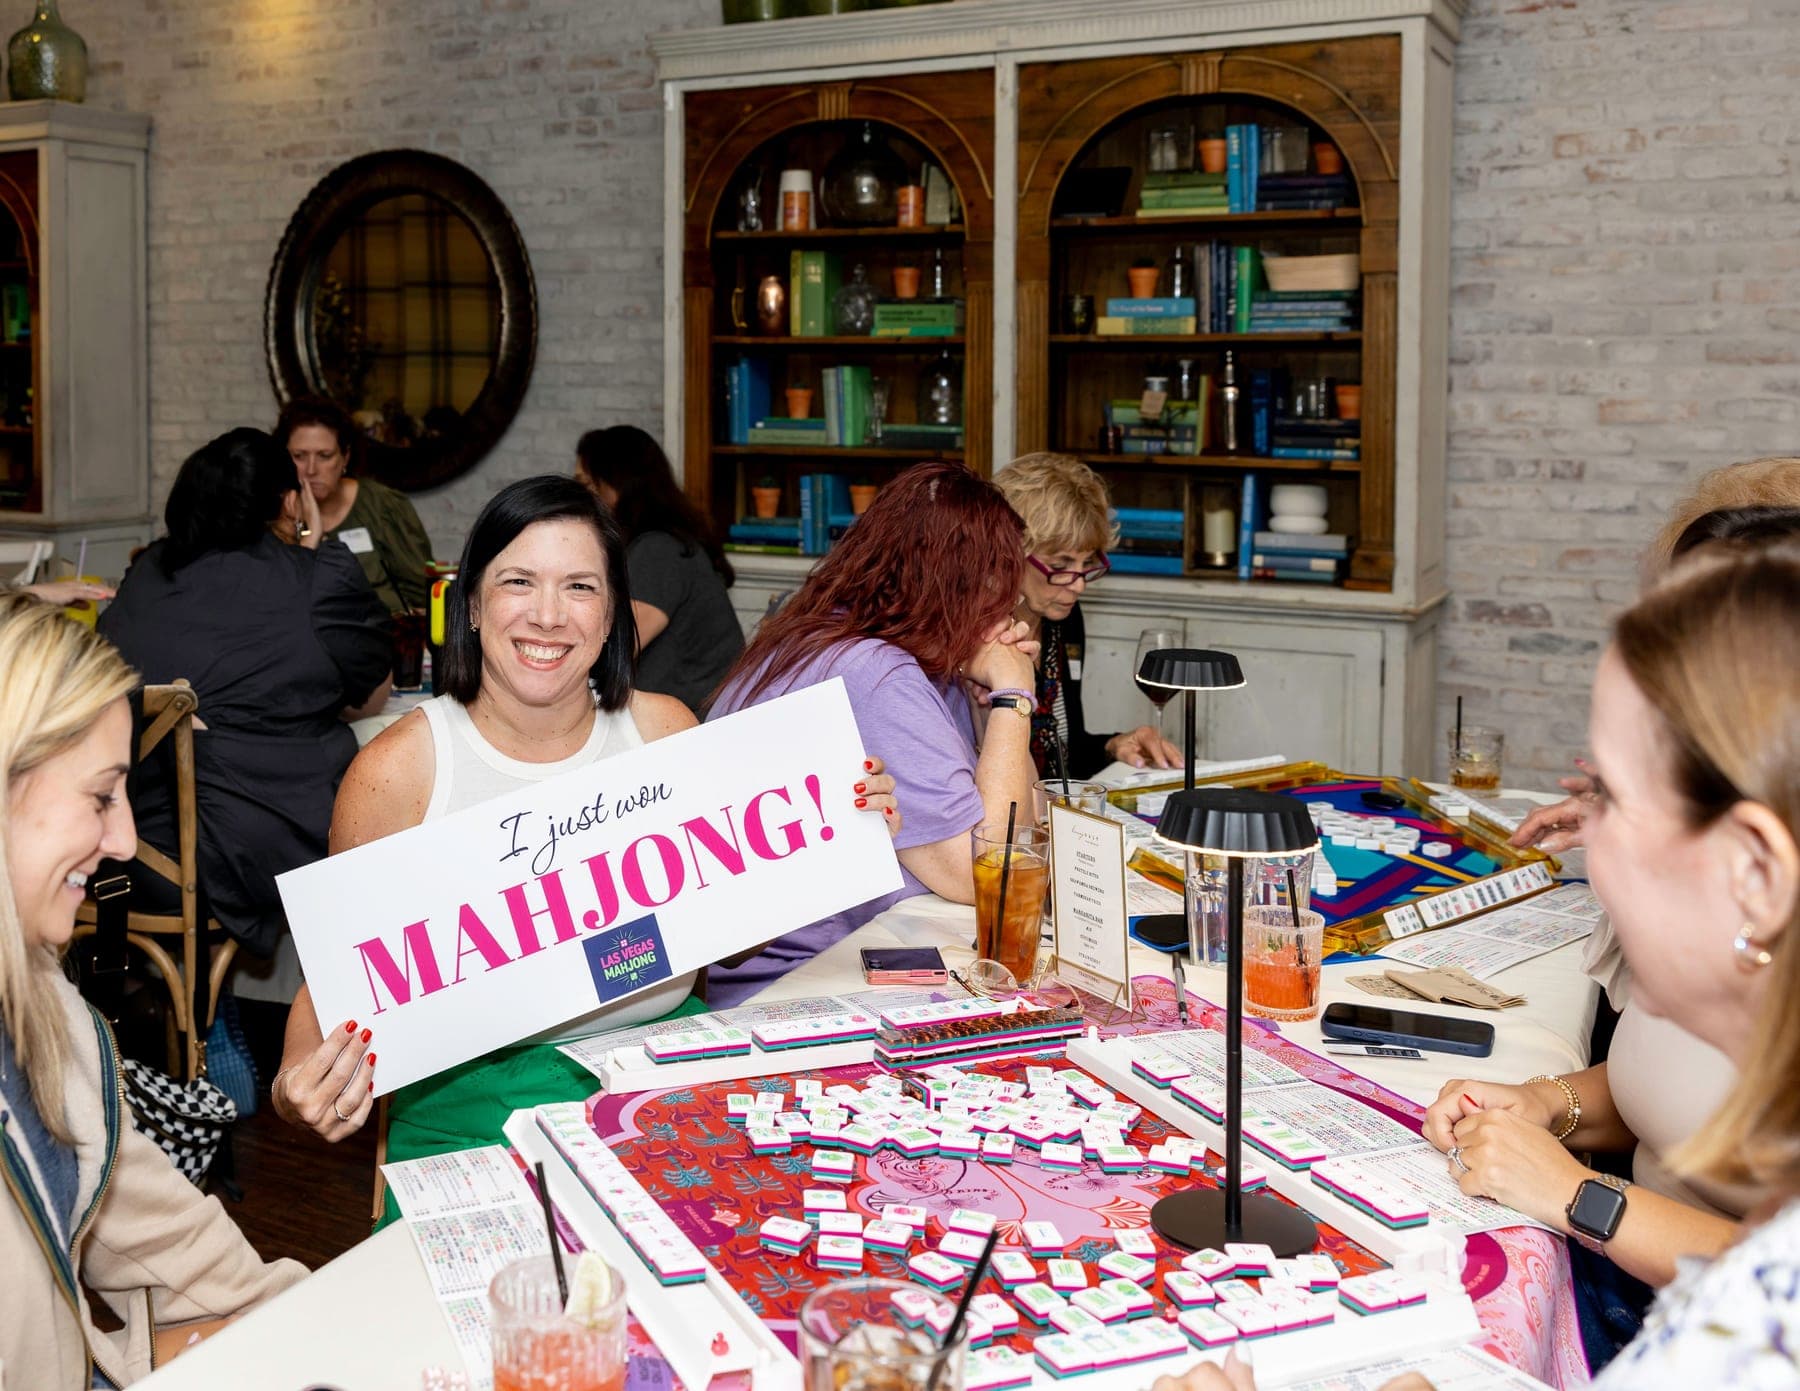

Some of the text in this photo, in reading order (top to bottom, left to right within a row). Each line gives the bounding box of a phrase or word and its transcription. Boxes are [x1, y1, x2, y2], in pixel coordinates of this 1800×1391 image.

[499, 783, 673, 876] I just won
[353, 774, 835, 1015] MAHJONG!
[600, 938, 656, 969] LAS VEGAS
[603, 951, 657, 981] MAHJONG
